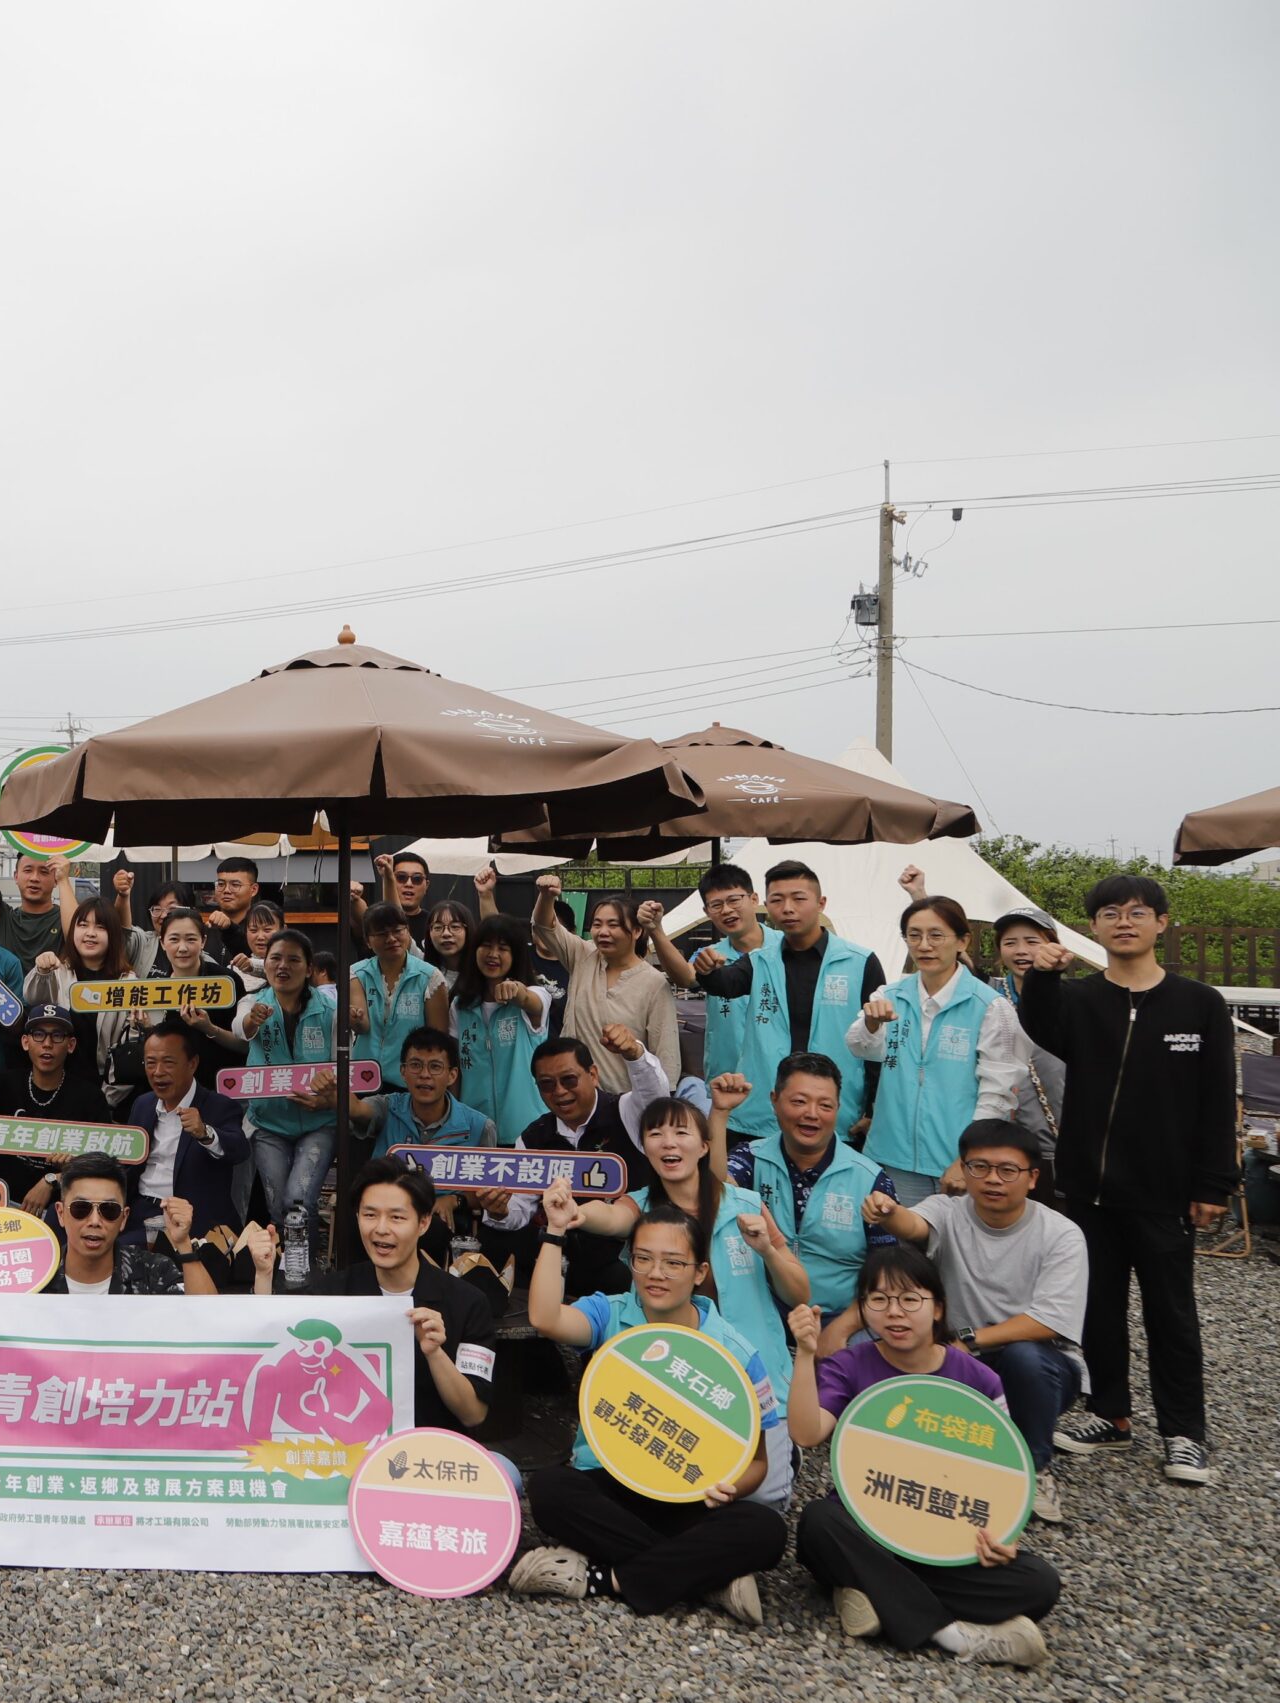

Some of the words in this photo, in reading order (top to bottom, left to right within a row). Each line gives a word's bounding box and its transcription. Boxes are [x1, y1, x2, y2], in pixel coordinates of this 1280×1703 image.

[507, 736, 547, 746] CAFÉ
[750, 796, 780, 804] CAFÉ
[105, 983, 223, 1008] 增能工作坊
[429, 1153, 576, 1185] 創業不設限
[664, 1354, 736, 1411] 東石鄉
[622, 1391, 701, 1454] 東石商圈
[913, 1407, 998, 1450] 布袋鎮
[592, 1397, 704, 1485] 觀光發展協會
[412, 1458, 480, 1484] 太保市
[862, 1468, 991, 1529] 洲南鹽場
[378, 1519, 488, 1555] 嘉蘊餐旅
